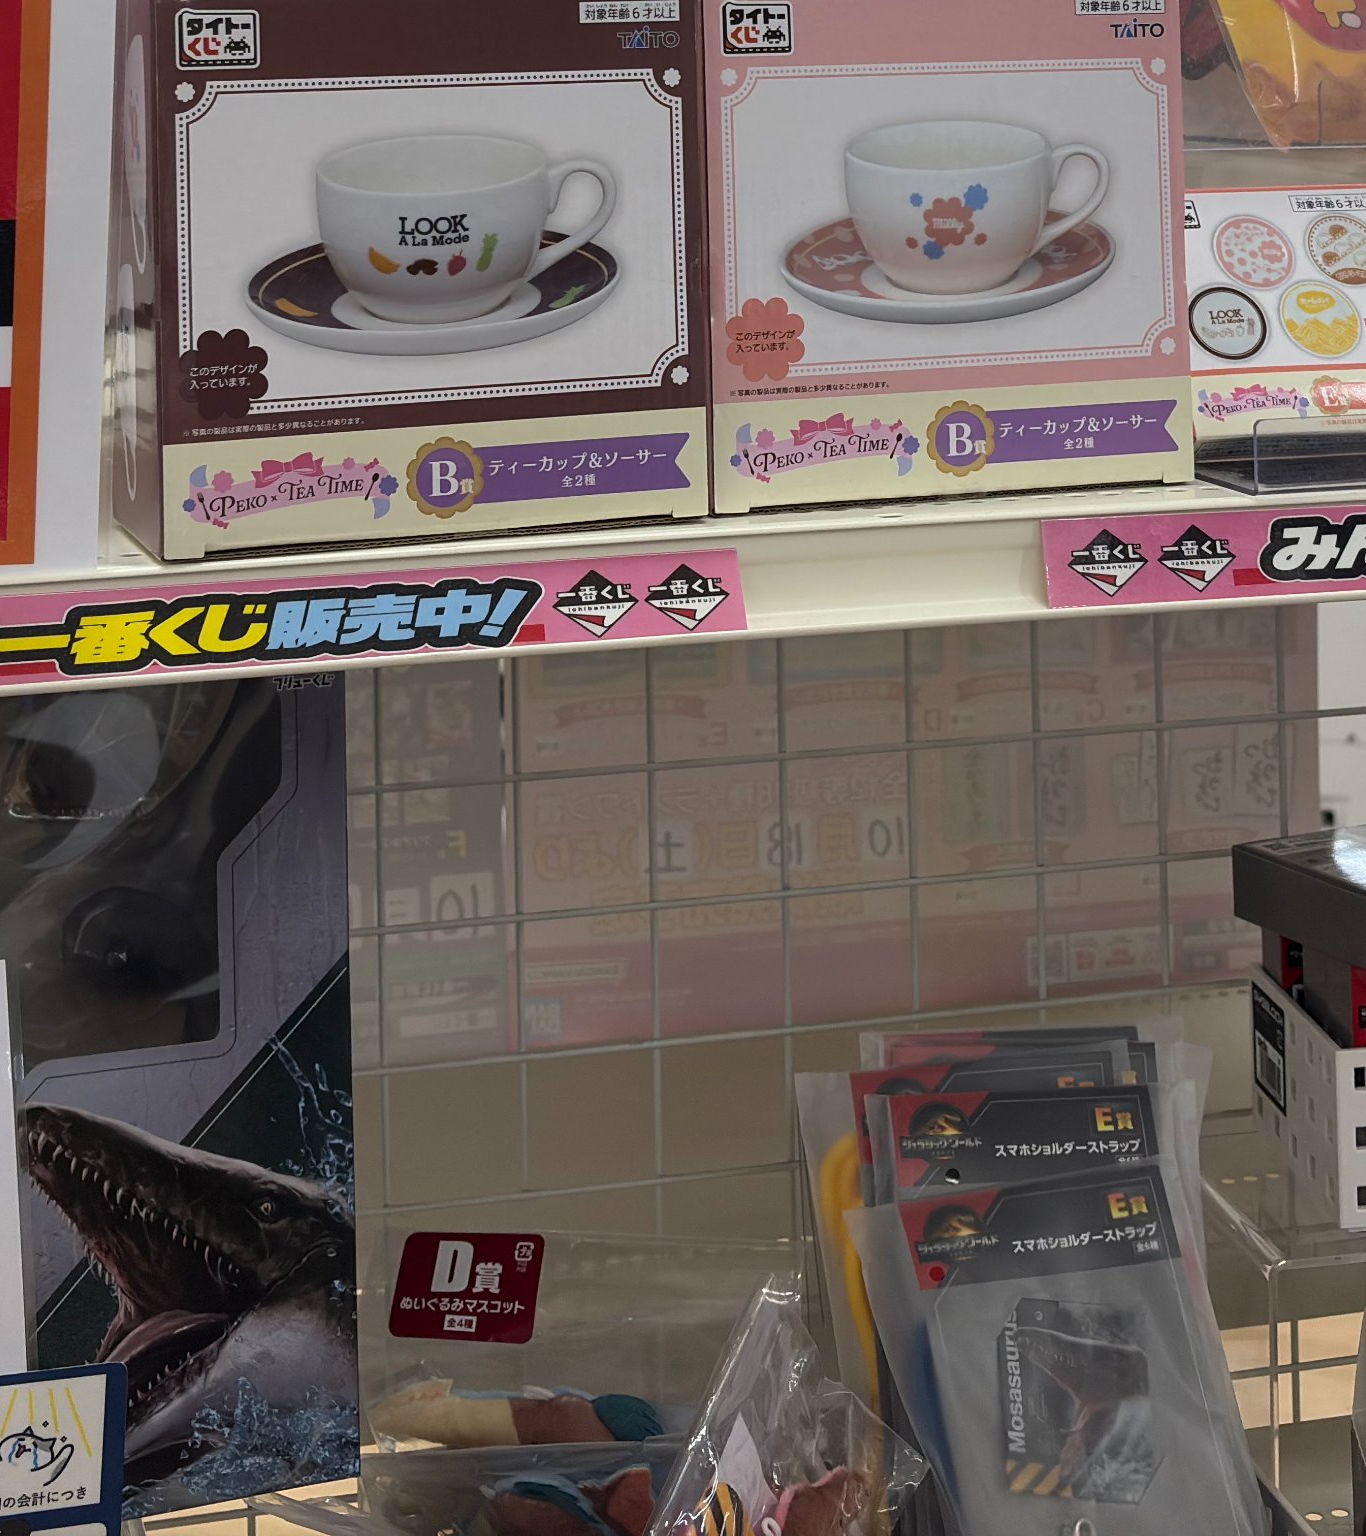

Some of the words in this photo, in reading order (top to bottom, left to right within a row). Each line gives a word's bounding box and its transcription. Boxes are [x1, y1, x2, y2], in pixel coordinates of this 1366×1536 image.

[729, 8, 787, 25] タイトー
[186, 17, 252, 36] タイトー
[729, 26, 761, 44] くじ
[187, 37, 222, 56] くじ
[398, 214, 470, 236] LOOK
[398, 236, 409, 246] A
[411, 235, 428, 247] La
[432, 233, 470, 246] Mode
[1208, 308, 1244, 320] LOOK
[735, 330, 796, 342] このデザインが
[735, 342, 790, 354] 入っています。
[190, 363, 258, 377] このデザインが
[190, 376, 251, 390] 入っています。
[998, 414, 1158, 439] ティーカップ&ソーサー
[1063, 437, 1096, 450] 全2種
[487, 448, 668, 477] ティーカップ&ソーサー
[753, 450, 806, 474] PEKO
[813, 439, 847, 459] TEA
[847, 433, 890, 454] TIME
[561, 472, 597, 488] 全2種
[207, 490, 269, 521] PEKO
[276, 481, 317, 504] TEA
[317, 473, 365, 496] TIME
[1070, 543, 1141, 564] 一番くじ
[1160, 538, 1229, 558] 一番くじ
[554, 580, 632, 605] 一番くじ
[644, 574, 723, 601] 一番くじ
[994, 1140, 1142, 1158] スマホショルダーストラップ
[1012, 1222, 1157, 1254] スマホショルダーストラップ
[430, 1239, 503, 1294] D賞
[399, 1296, 525, 1315] ぬいぐるみマスコット
[446, 1317, 474, 1329] 全4種
